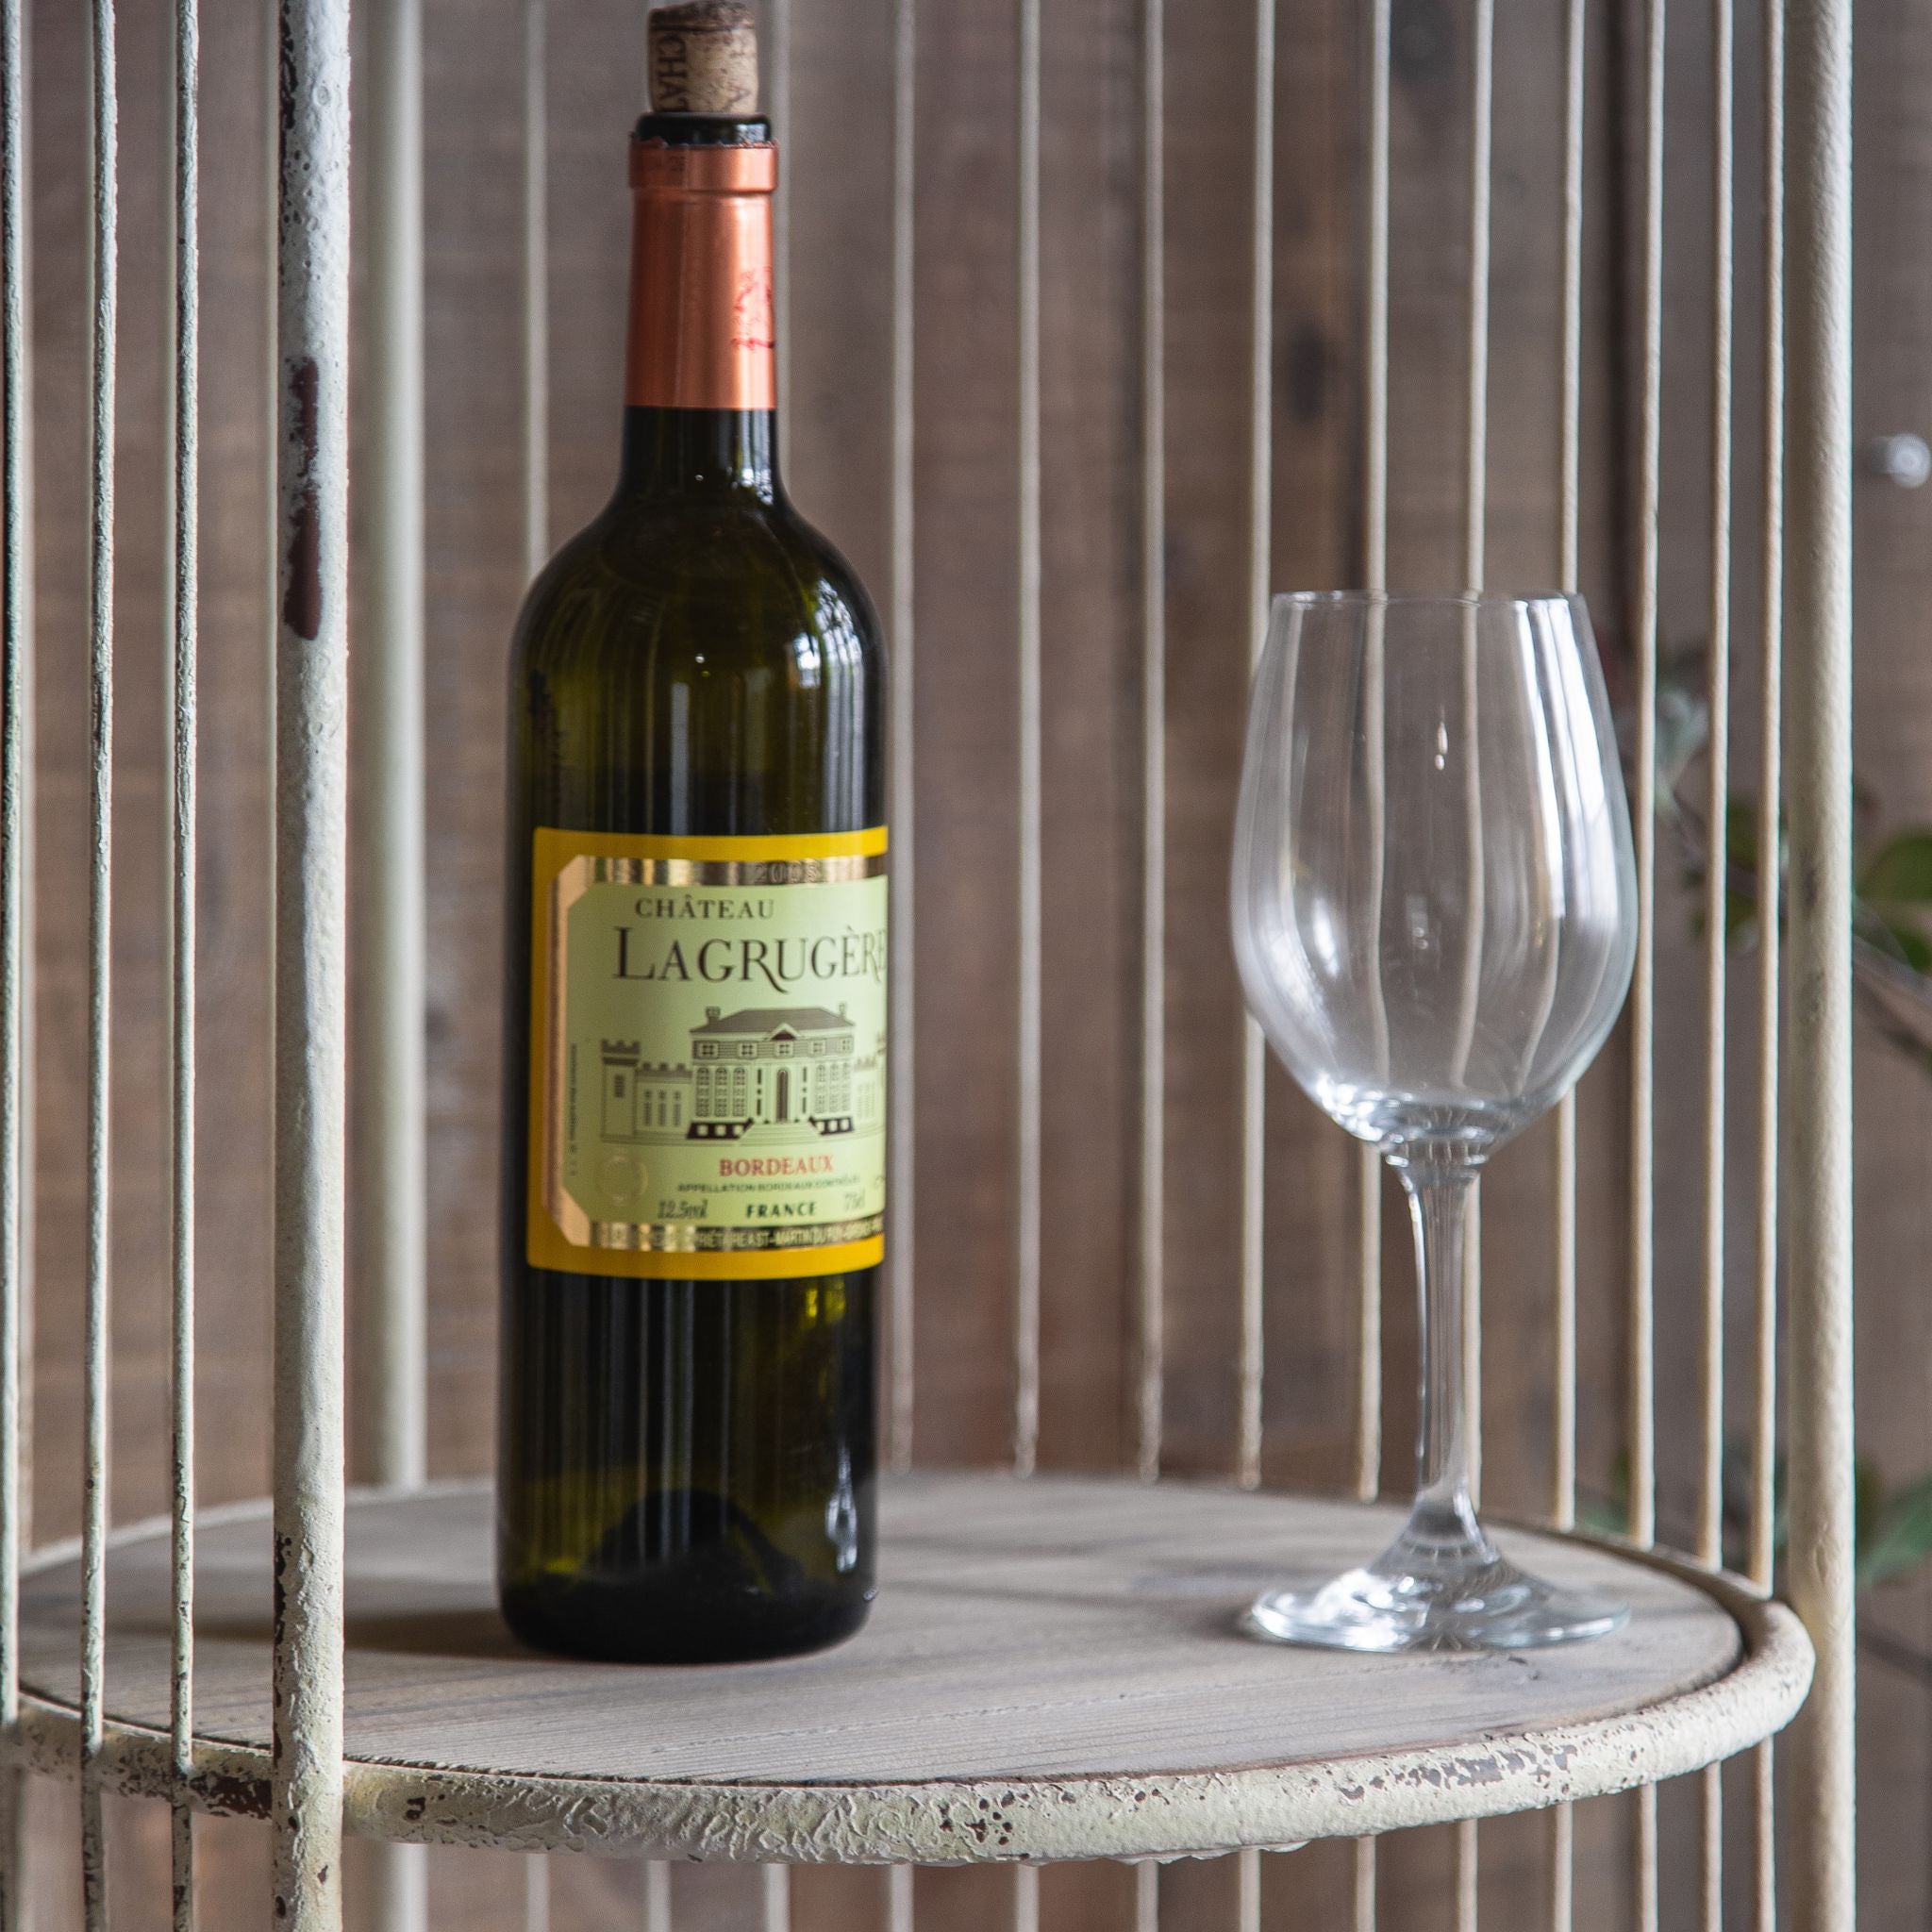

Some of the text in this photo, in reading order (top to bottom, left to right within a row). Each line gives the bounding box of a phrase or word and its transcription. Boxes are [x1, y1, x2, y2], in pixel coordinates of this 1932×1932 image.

[634, 894, 775, 921] CHÂTEAU
[719, 1154, 834, 1177] BORDEAUX
[746, 1201, 816, 1219] FRANCE
